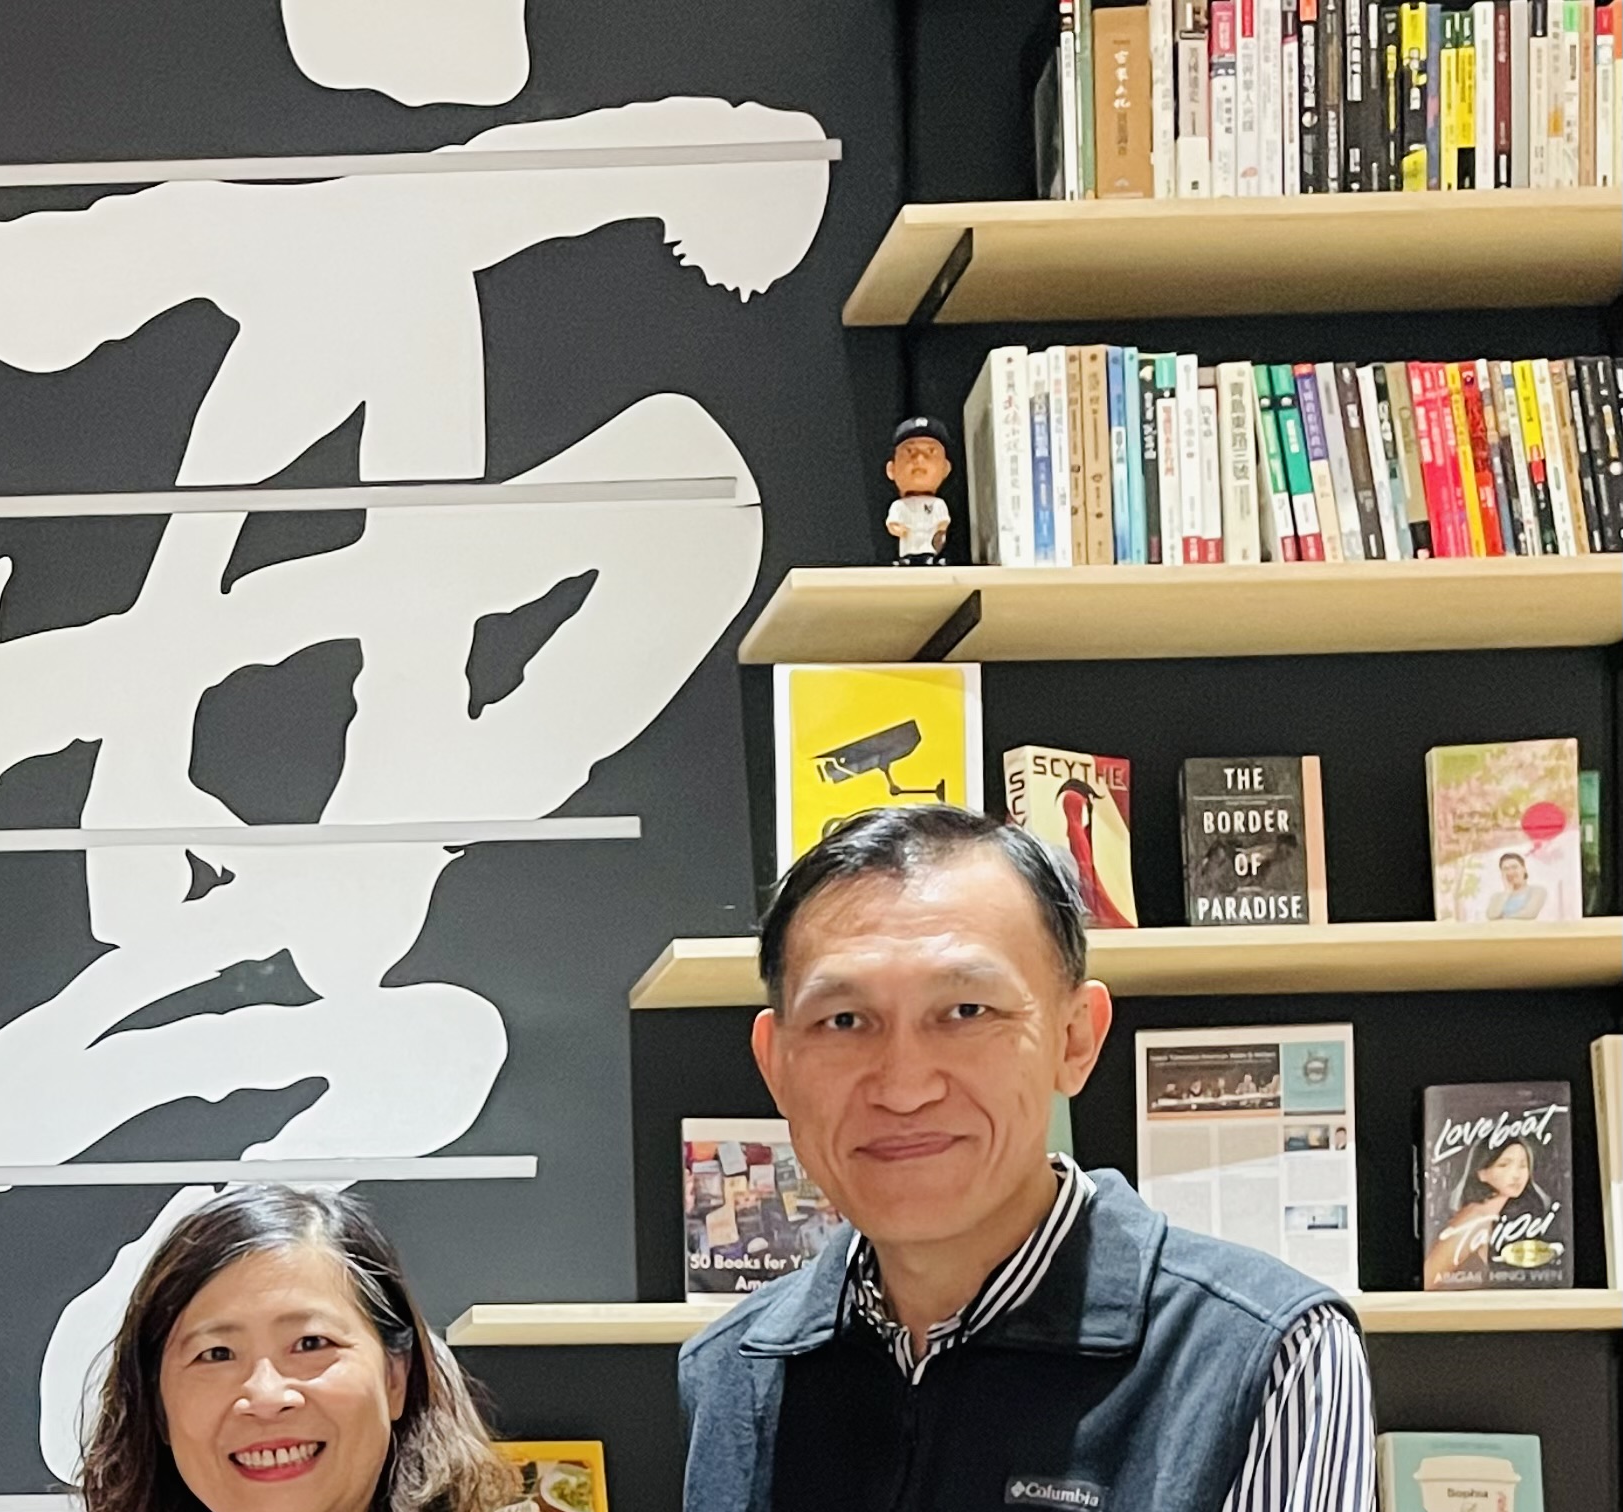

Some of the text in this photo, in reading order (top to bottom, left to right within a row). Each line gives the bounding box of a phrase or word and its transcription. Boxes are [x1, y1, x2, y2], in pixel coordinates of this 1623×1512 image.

[1033, 755, 1125, 788] SCYTHE
[1223, 767, 1265, 791] THE
[1203, 809, 1290, 834] BORDER
[1233, 852, 1263, 877] OF
[1197, 895, 1303, 921] PARADISE
[689, 1253, 712, 1269] 50
[713, 1253, 761, 1270] Books
[763, 1252, 787, 1270] for
[1024, 1481, 1099, 1507] Columbia
